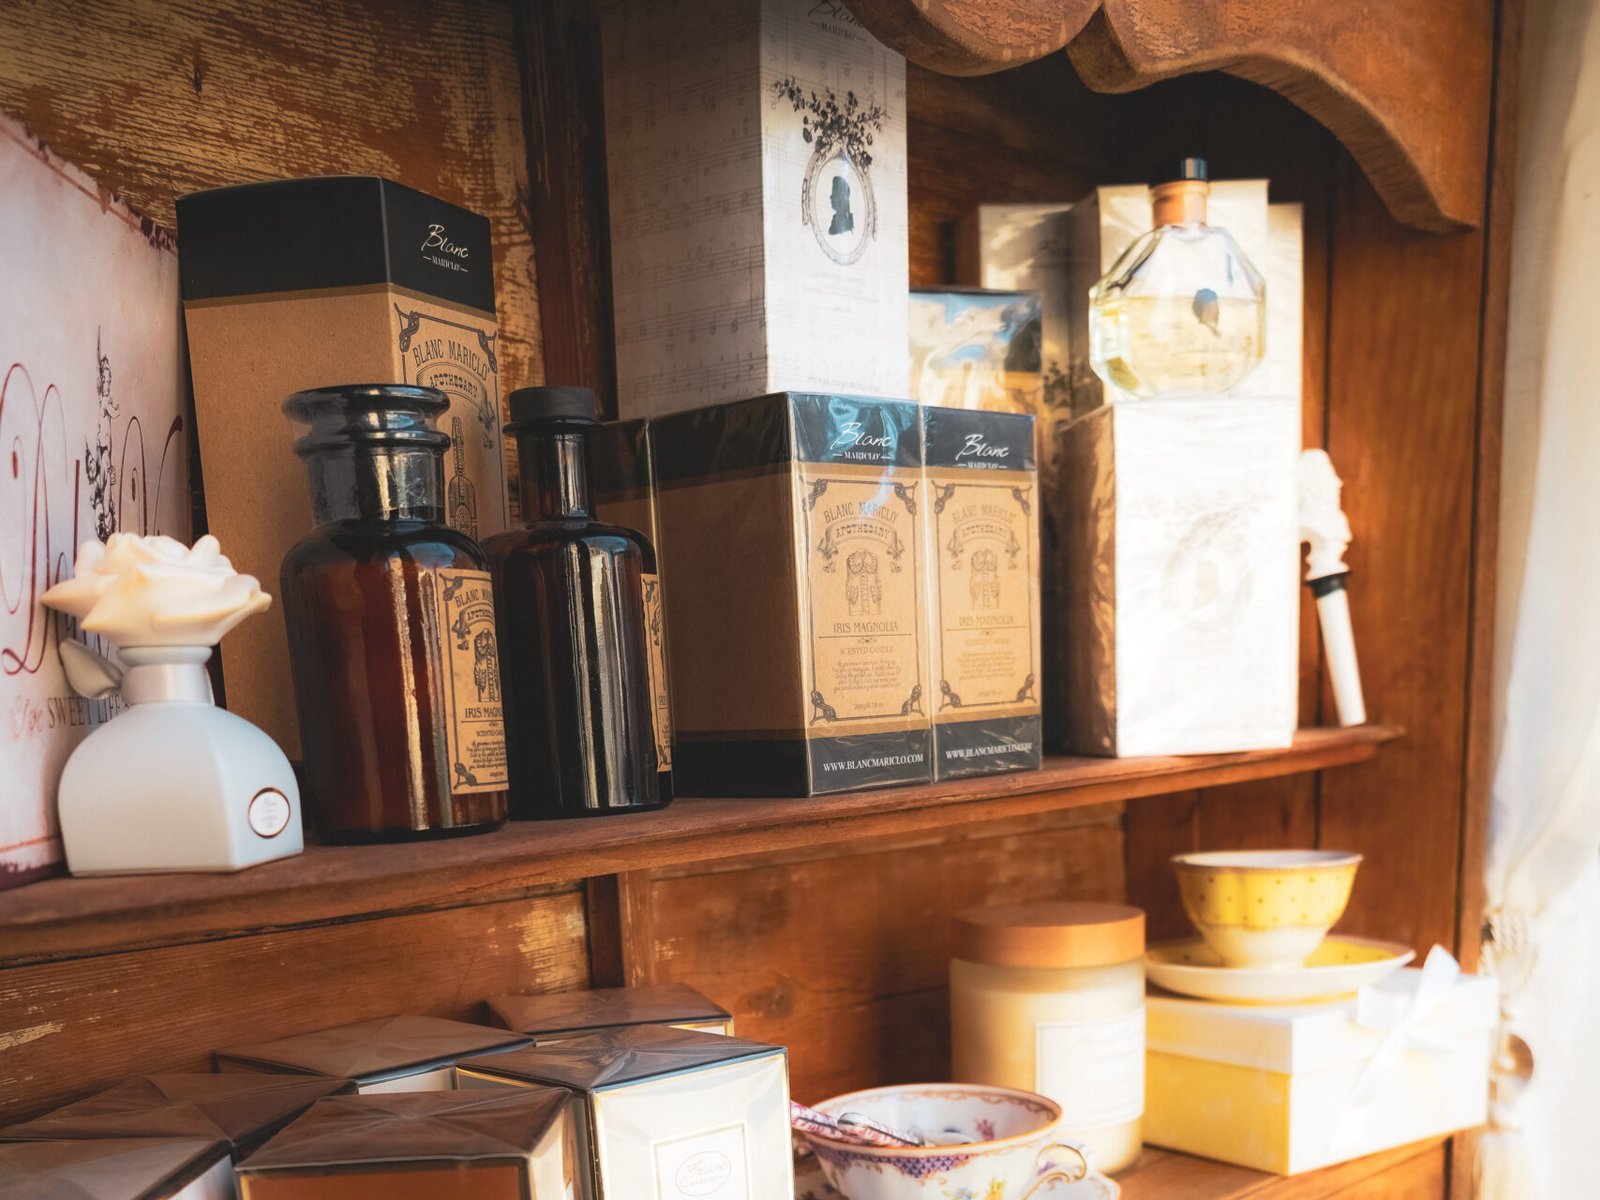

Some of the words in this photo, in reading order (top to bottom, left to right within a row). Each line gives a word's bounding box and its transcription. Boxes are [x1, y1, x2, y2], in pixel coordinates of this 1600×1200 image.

[420, 224, 469, 258] Blanc
[412, 338, 445, 368] BLANC
[447, 339, 491, 382] MARICLO'
[429, 373, 479, 399] APOTHECARY
[829, 421, 893, 450] Blanc
[954, 433, 1010, 461] Blanc
[823, 502, 854, 524] BLANC
[858, 501, 900, 524] MARICLO'
[951, 504, 978, 525] BLANC
[835, 522, 891, 539] APOTHECARY
[454, 588, 480, 608] BLANC
[833, 622, 851, 634] IRIS
[853, 621, 899, 633] MAGNOLIA
[959, 616, 974, 627] IRIS
[975, 614, 1015, 626] MAGNOLIA
[47, 696, 92, 729] SWEET
[464, 706, 482, 719] IRIS
[823, 753, 924, 772] WWW.BLANCMARICLO.COM
